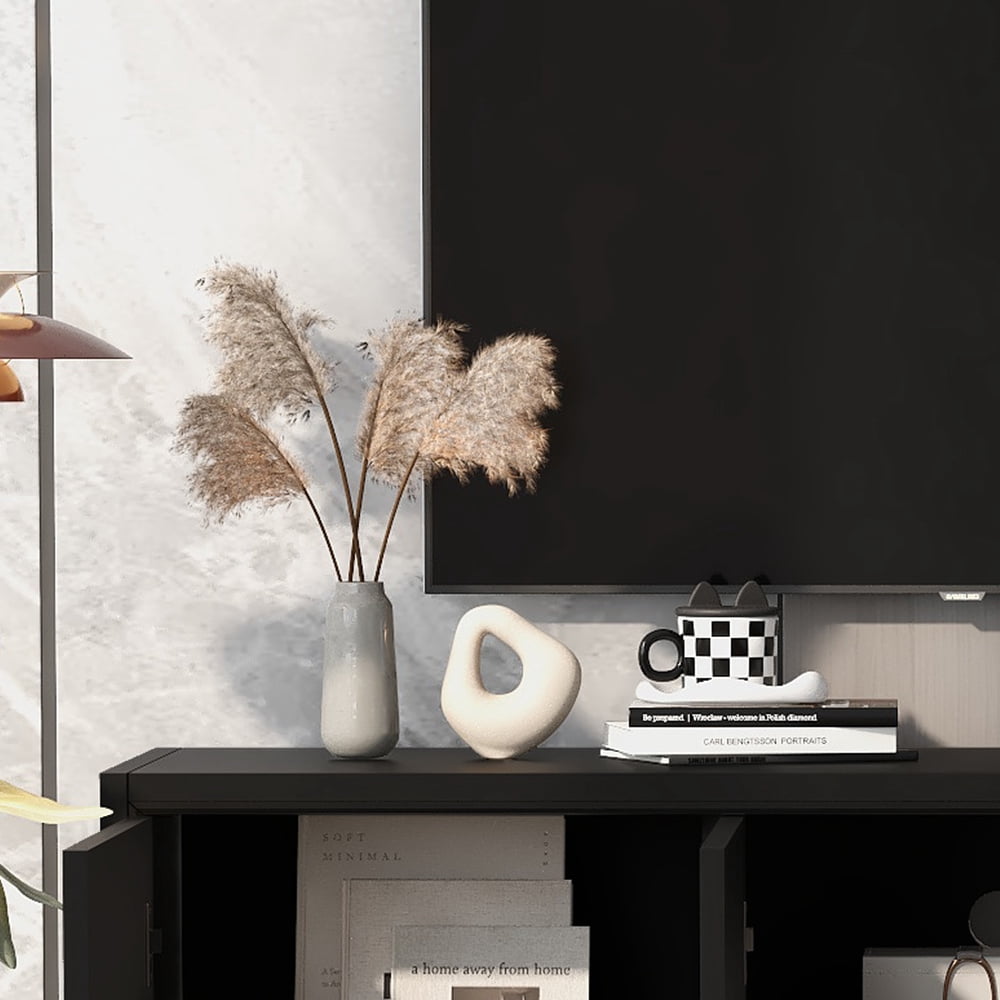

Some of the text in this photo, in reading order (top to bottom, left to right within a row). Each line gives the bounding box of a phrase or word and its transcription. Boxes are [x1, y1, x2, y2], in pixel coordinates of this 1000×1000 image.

[642, 713, 653, 723] Be
[703, 736, 828, 746] CARL BENGTSSON PORTRAITS
[321, 831, 367, 843] SOFT
[321, 851, 402, 862] MINIMAL
[411, 962, 571, 979] a home away from home
